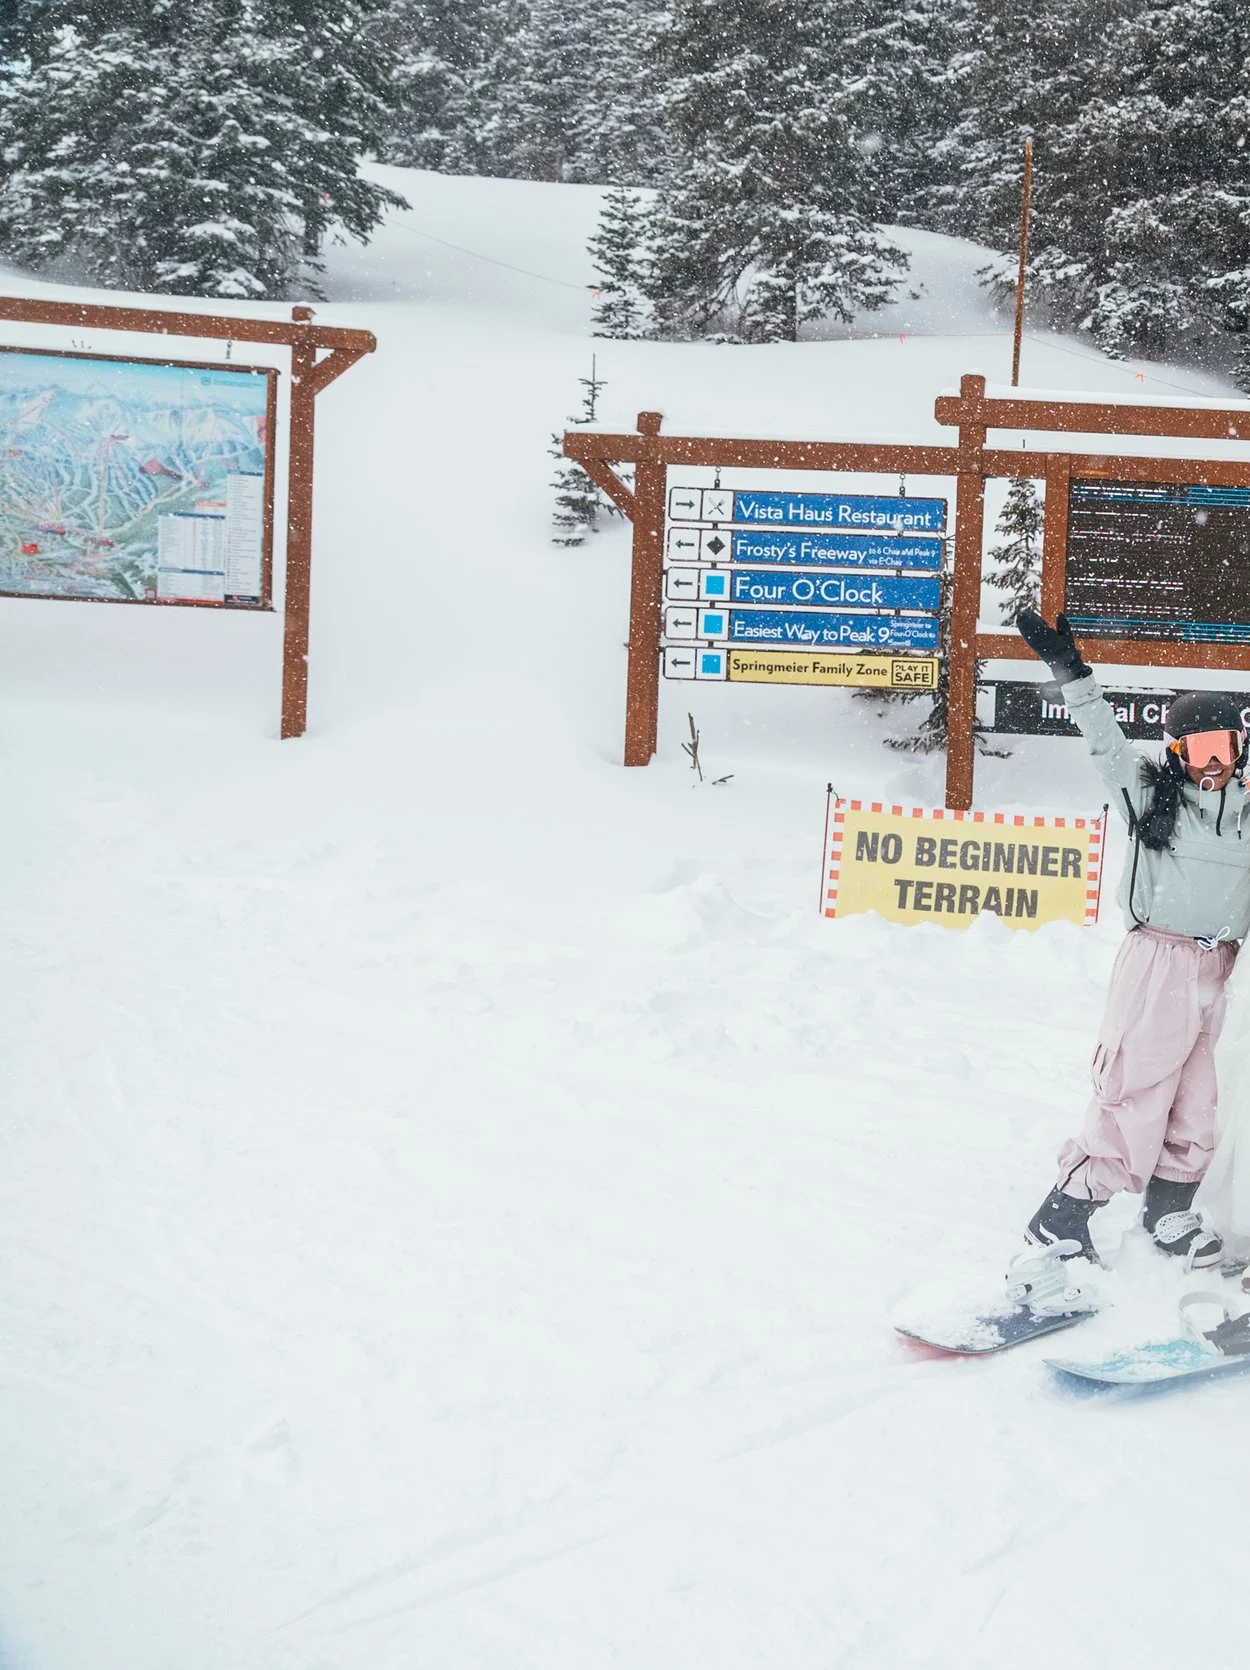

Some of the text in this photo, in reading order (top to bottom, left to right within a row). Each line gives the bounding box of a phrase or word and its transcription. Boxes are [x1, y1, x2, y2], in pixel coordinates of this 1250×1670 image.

[738, 501, 932, 527] Vista Haus Restaurant
[735, 539, 867, 564] Frosty's Freeway
[882, 547, 900, 556] Chair
[914, 548, 930, 557] Peak
[735, 578, 884, 605] Four O'Clock
[734, 621, 890, 645] Easiest Way to Peak 9
[732, 658, 888, 679] Springmeier Family Zone
[895, 664, 919, 672] PLAY
[895, 672, 930, 683] SAFE
[855, 831, 1082, 879] NO BEGINNER
[893, 878, 1039, 918] TERRAIN
